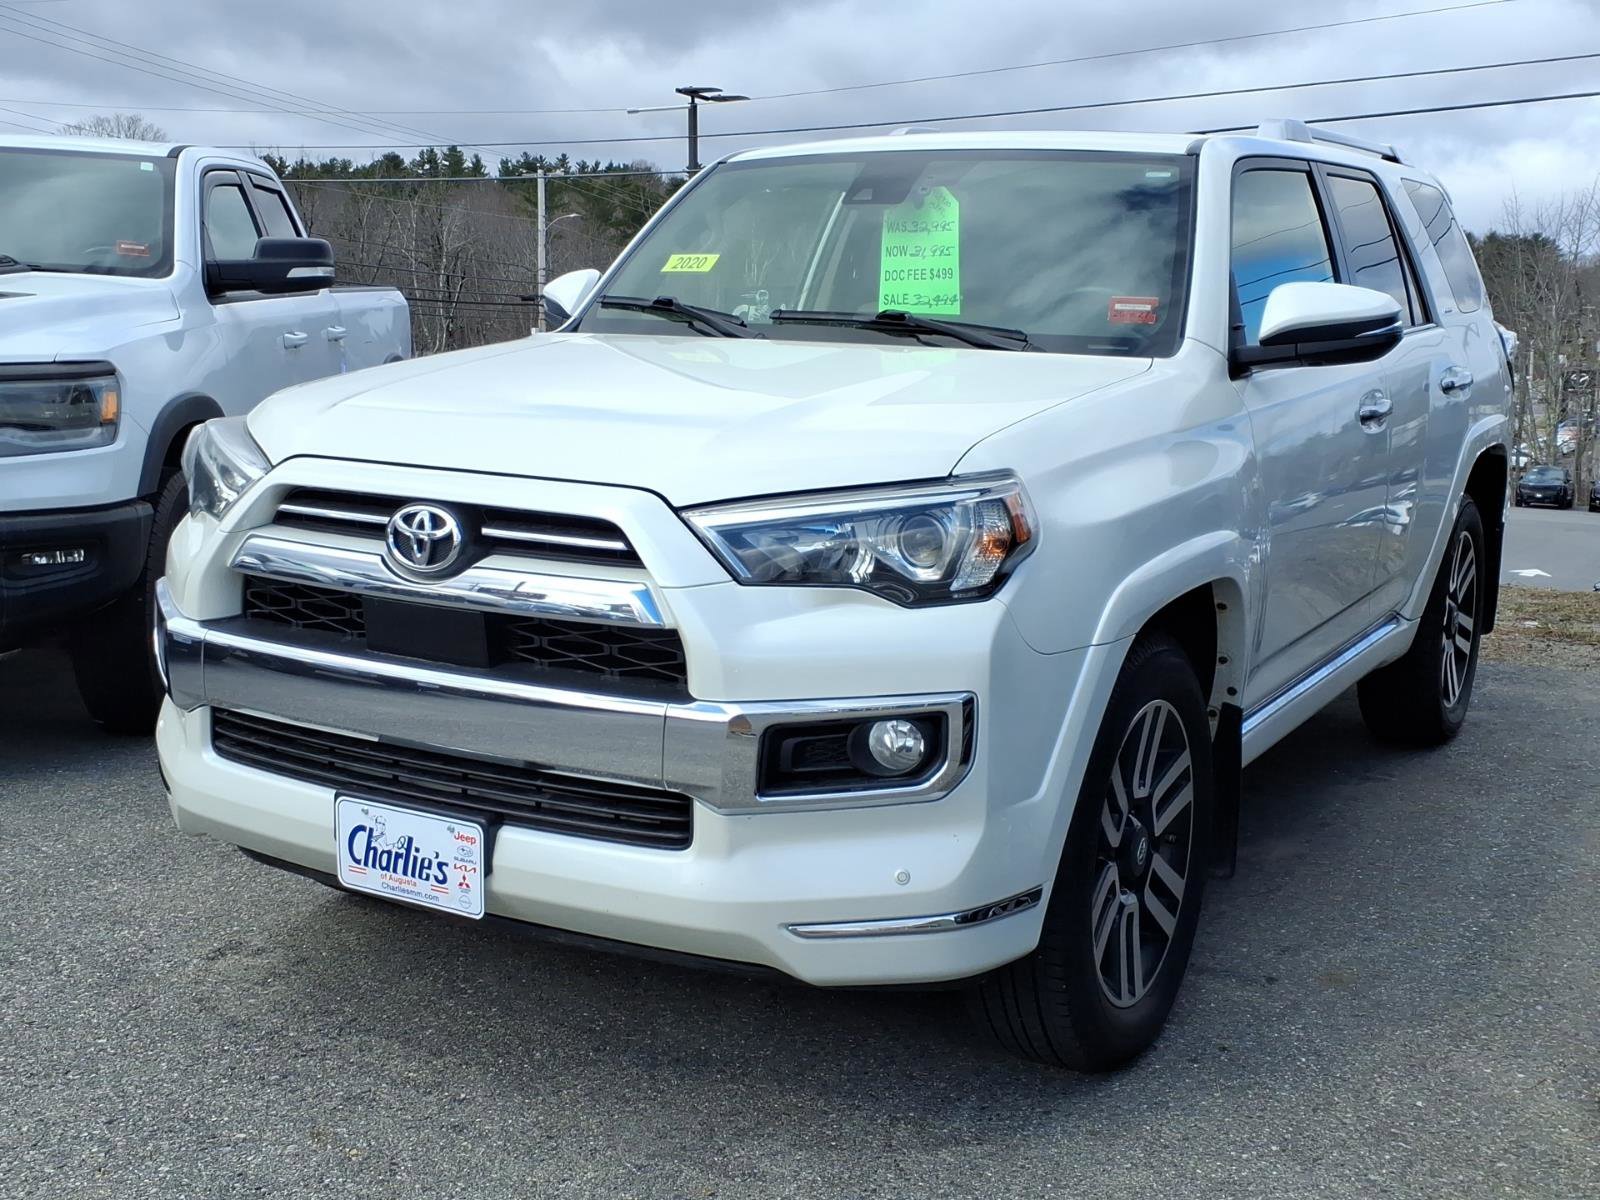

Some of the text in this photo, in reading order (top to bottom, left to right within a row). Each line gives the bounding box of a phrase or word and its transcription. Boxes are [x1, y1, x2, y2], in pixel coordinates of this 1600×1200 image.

[886, 221, 907, 233] WAS
[885, 245, 908, 258] NOW
[671, 256, 708, 269] 2020
[884, 267, 954, 282] DOC FEE $499
[883, 293, 909, 306] SALE
[454, 831, 477, 846] Jeep
[347, 823, 450, 885] Charlie's
[380, 873, 417, 888] of Augusta
[381, 881, 440, 903] Charliesmm.com
